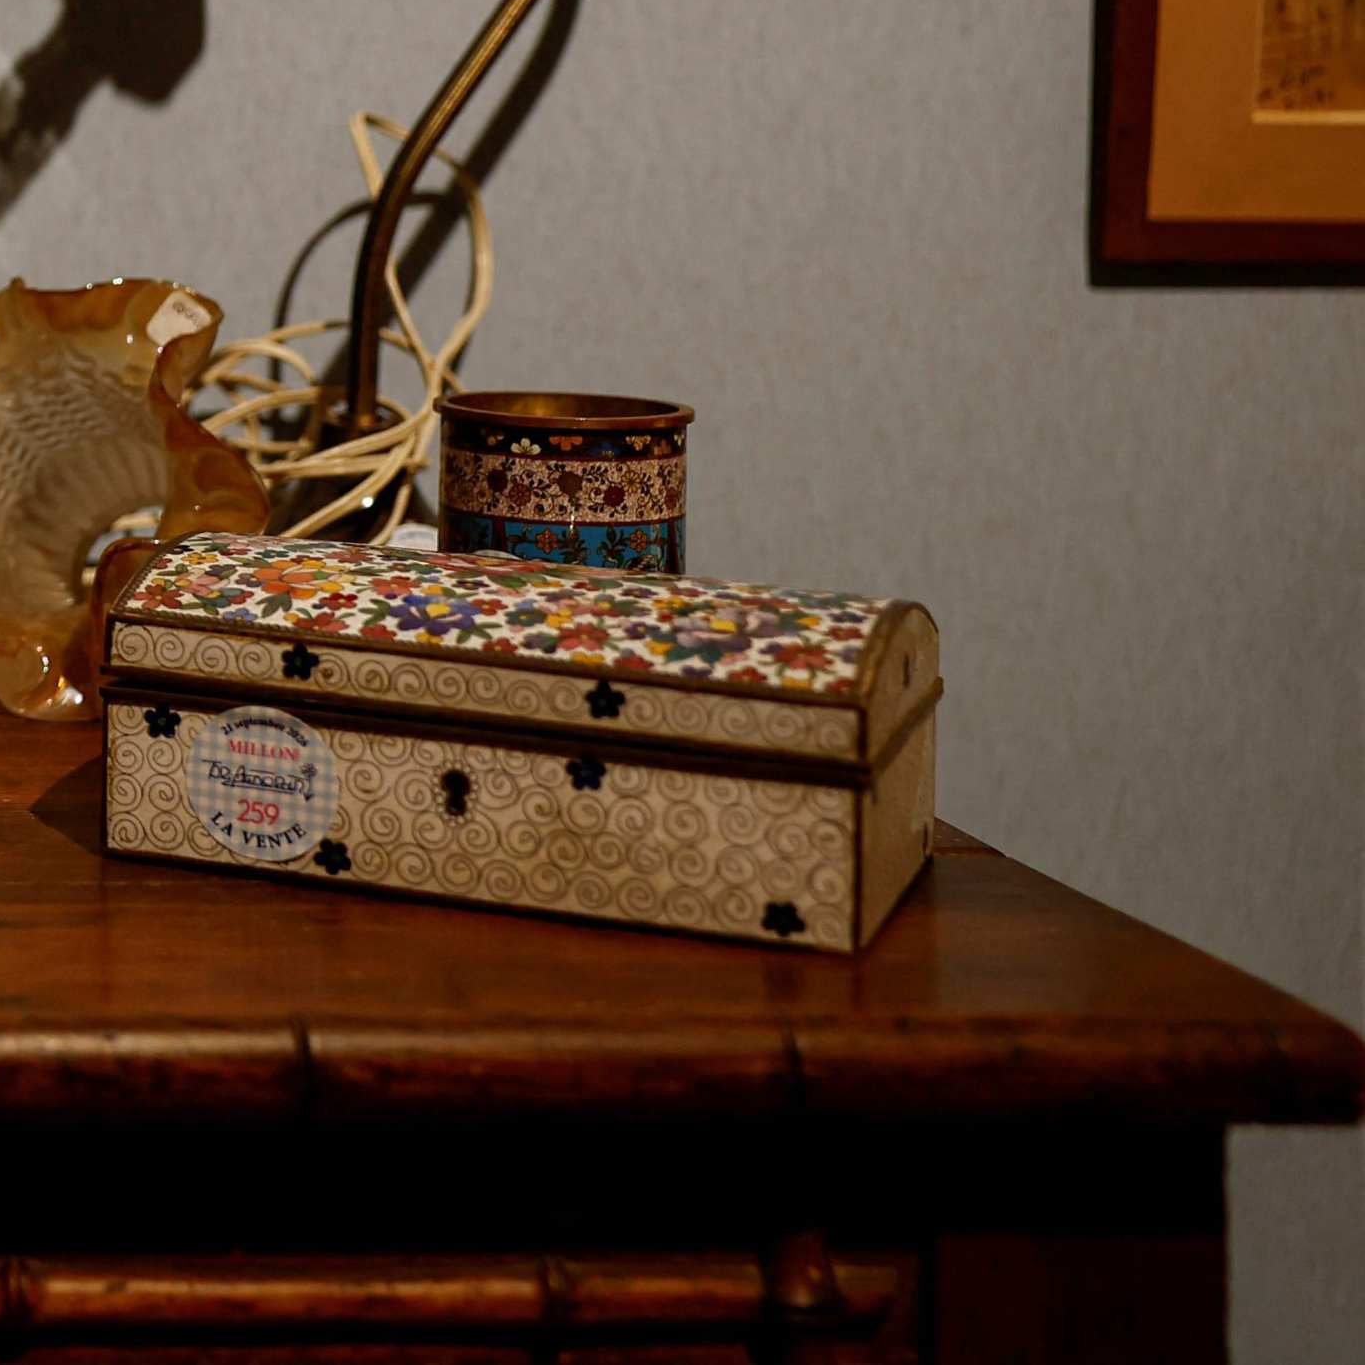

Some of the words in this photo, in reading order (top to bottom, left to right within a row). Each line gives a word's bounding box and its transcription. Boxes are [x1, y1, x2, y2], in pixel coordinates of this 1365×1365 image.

[227, 738, 301, 761] MILLON
[236, 797, 281, 826] 259
[210, 810, 233, 838] LA
[241, 822, 308, 849] VENTE
